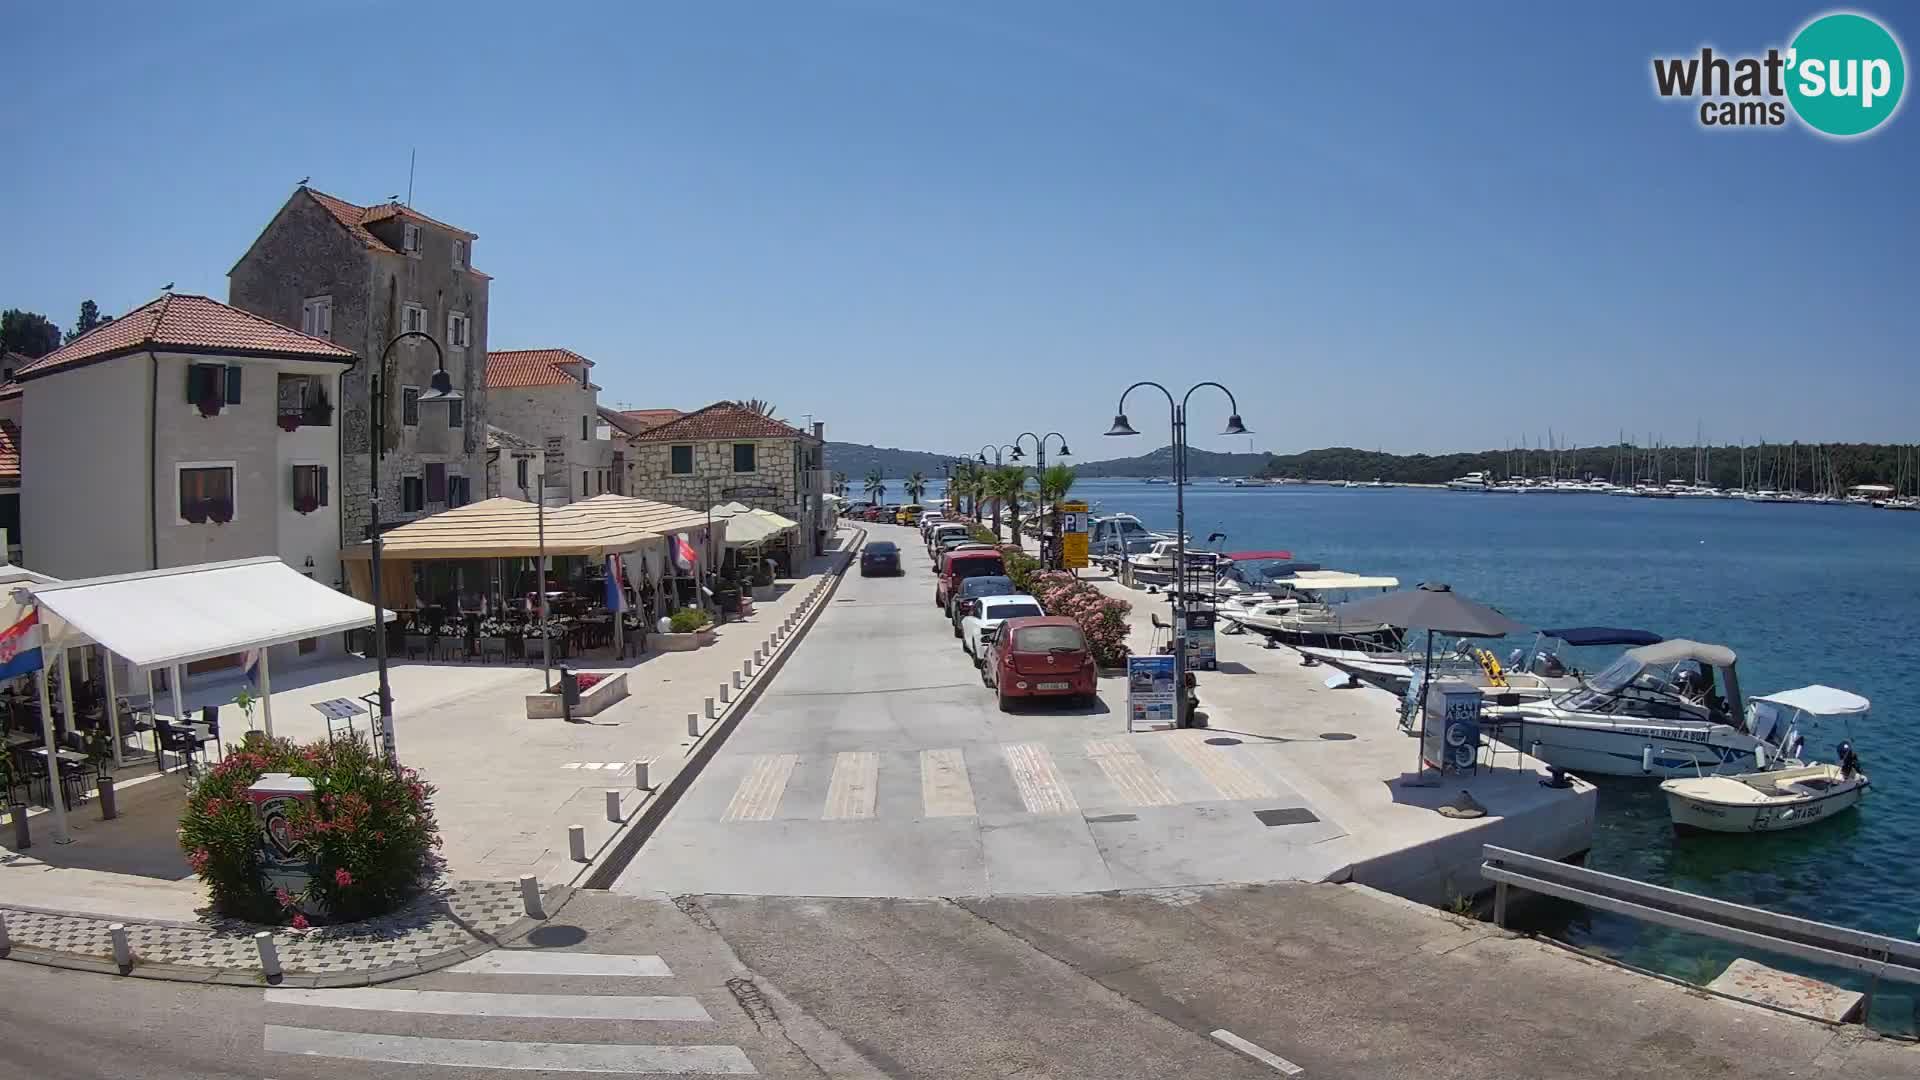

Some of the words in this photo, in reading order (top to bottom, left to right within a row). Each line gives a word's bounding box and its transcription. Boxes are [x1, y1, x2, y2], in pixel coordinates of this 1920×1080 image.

[1065, 514, 1076, 531] P
[1447, 703, 1478, 712] RENT
[1447, 711, 1454, 720] A
[1455, 711, 1477, 720] BOAT
[1662, 729, 1681, 739] RENT
[1691, 731, 1711, 742] BOAT
